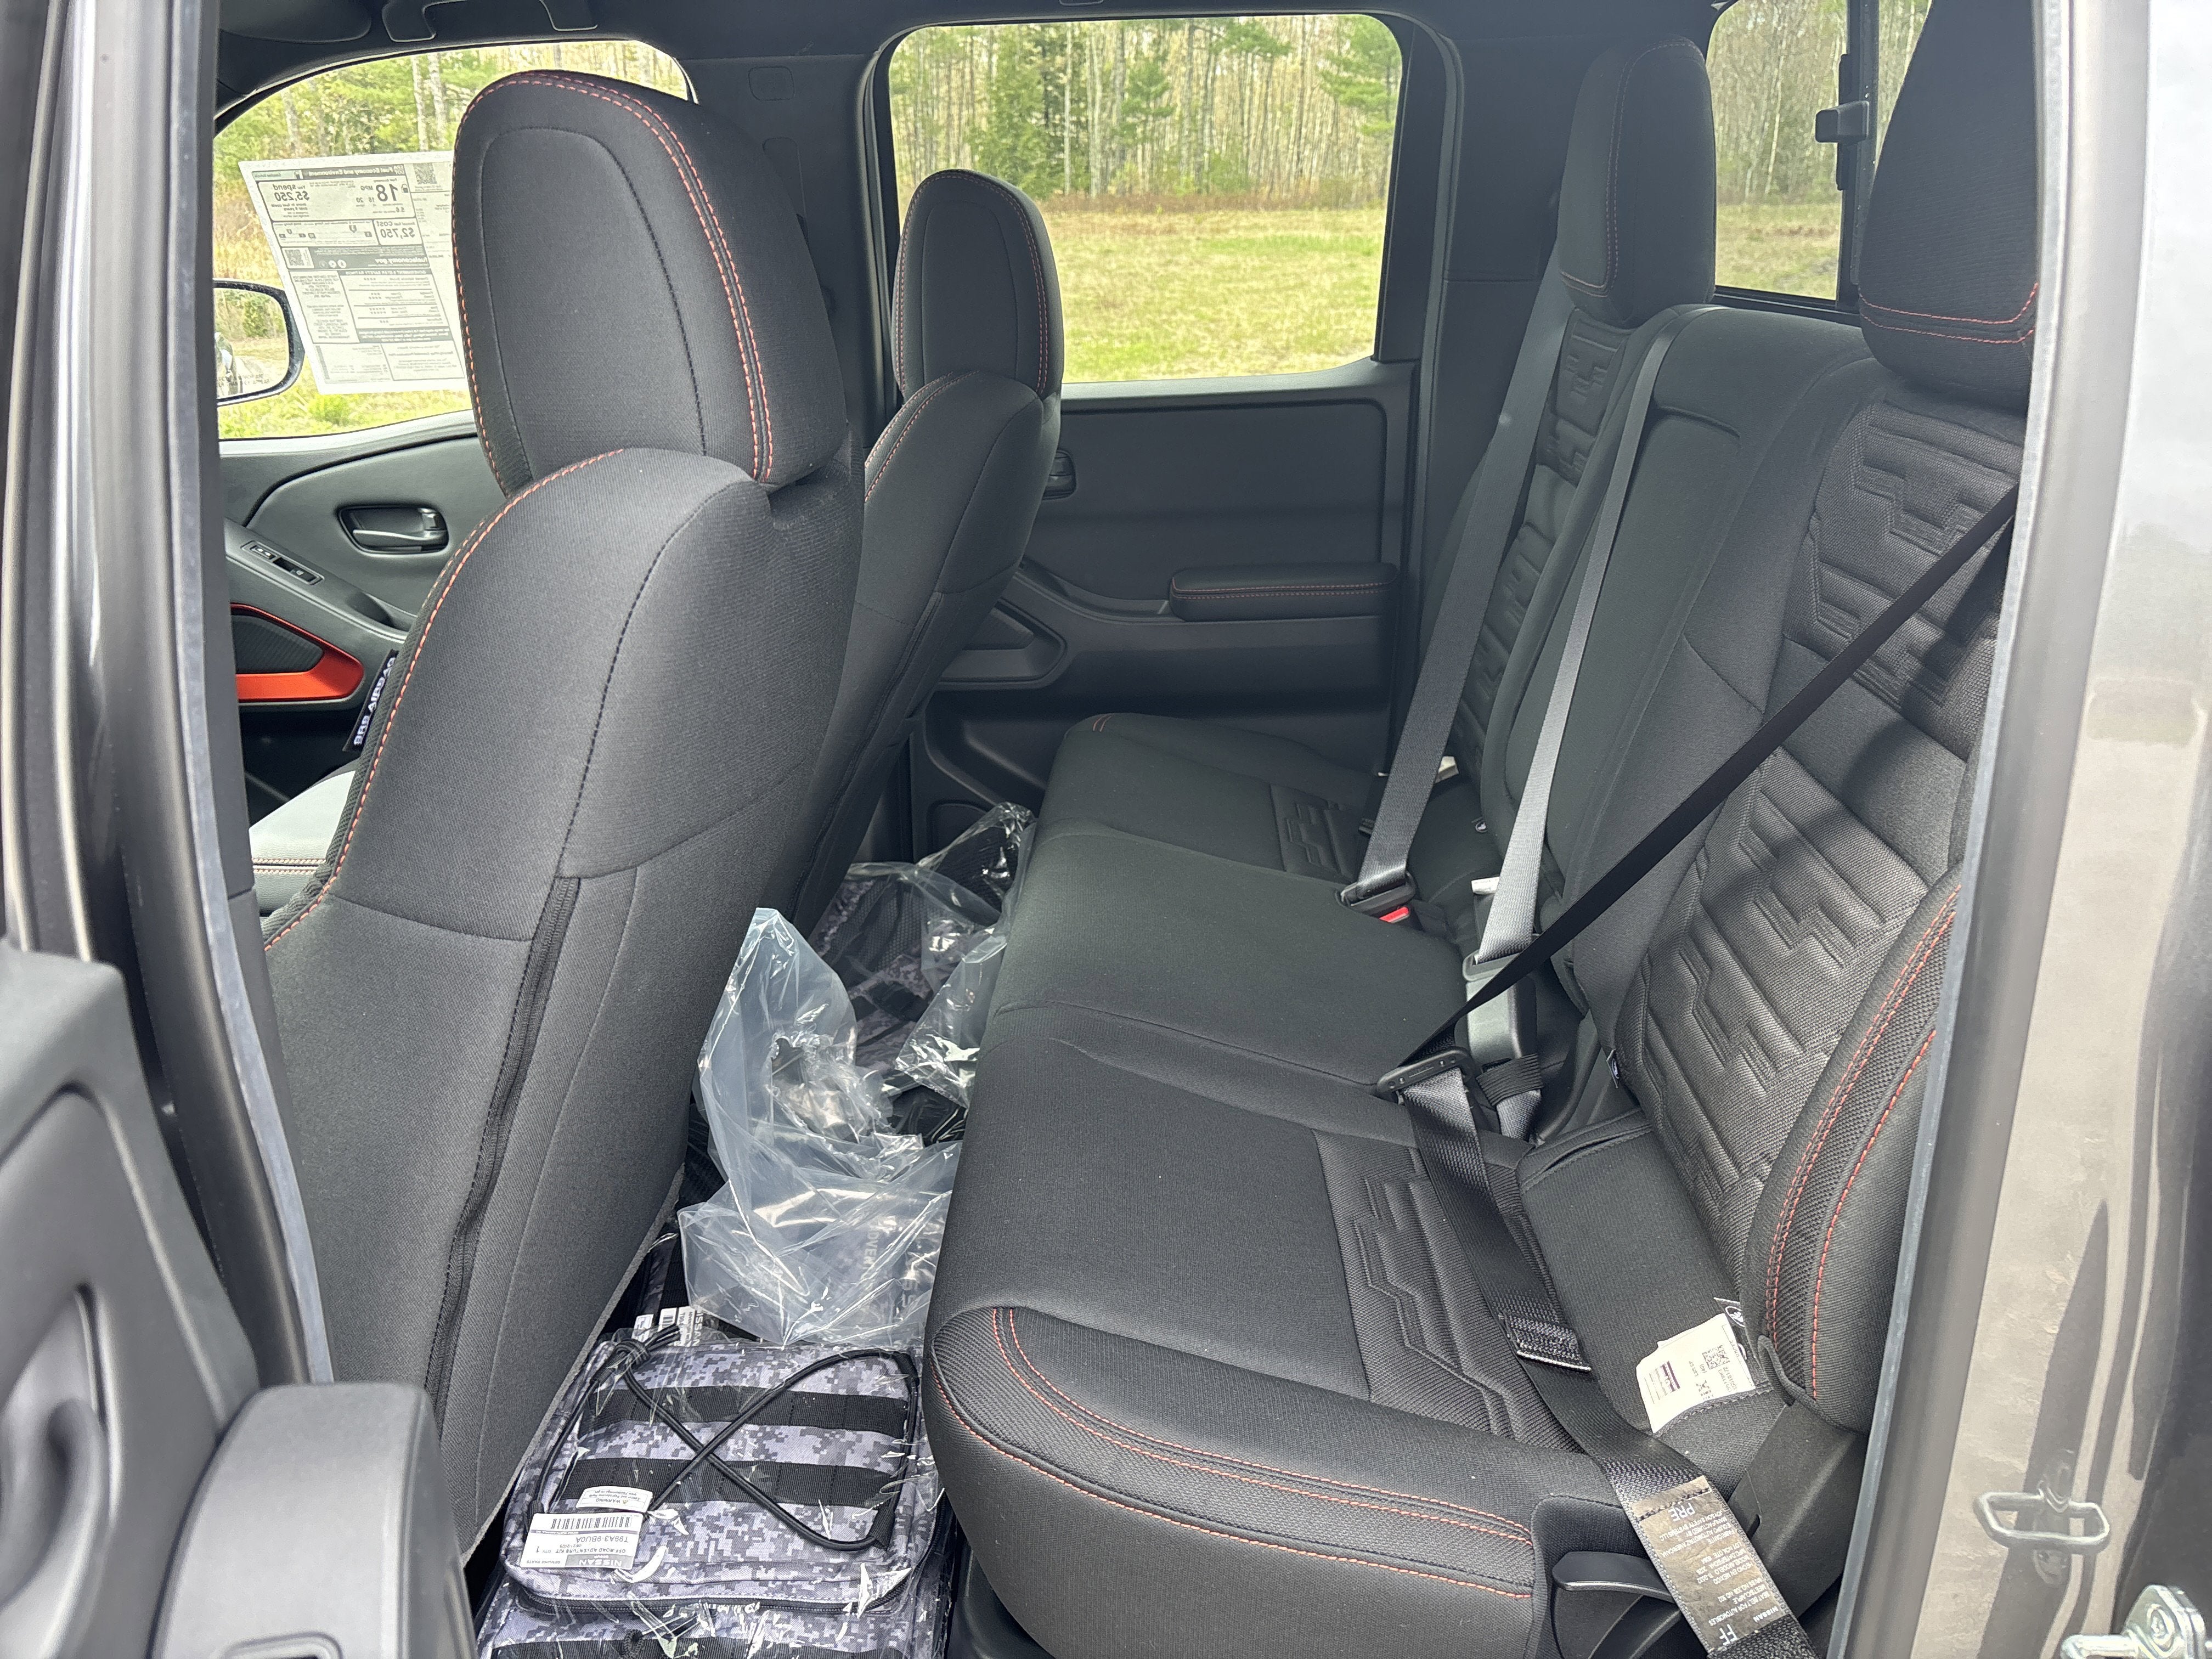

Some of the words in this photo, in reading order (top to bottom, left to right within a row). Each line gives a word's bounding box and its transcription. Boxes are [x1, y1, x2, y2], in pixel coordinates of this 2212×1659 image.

[368, 657, 397, 713] AIRBAG
[1667, 1503, 1695, 1521] PRE
[1704, 1510, 1722, 1521] JOYSON
[1688, 1517, 1705, 1528] SAFETY
[1691, 1516, 1727, 1534] MANUFACTURED
[1713, 1522, 1731, 1533] EQUIPO
[1659, 1532, 1669, 1541] LLC
[1667, 1523, 1689, 1537] SYSTEMS
[1707, 1528, 1735, 1544] FABRICANTE
[1685, 1530, 1713, 1546] AUTOMOTRIZ
[1660, 1542, 1686, 1557] AMERICANA
[1736, 1561, 1753, 1572] HECHO
[1713, 1572, 1731, 1584] MEXICO
[1747, 1596, 1758, 1606] BELT
[1758, 1590, 1770, 1601] SEAT
[1737, 1602, 1747, 1611] FOR
[1708, 1607, 1737, 1626] AUTOMOBILES
[1753, 1606, 1778, 1621] NISSAN
